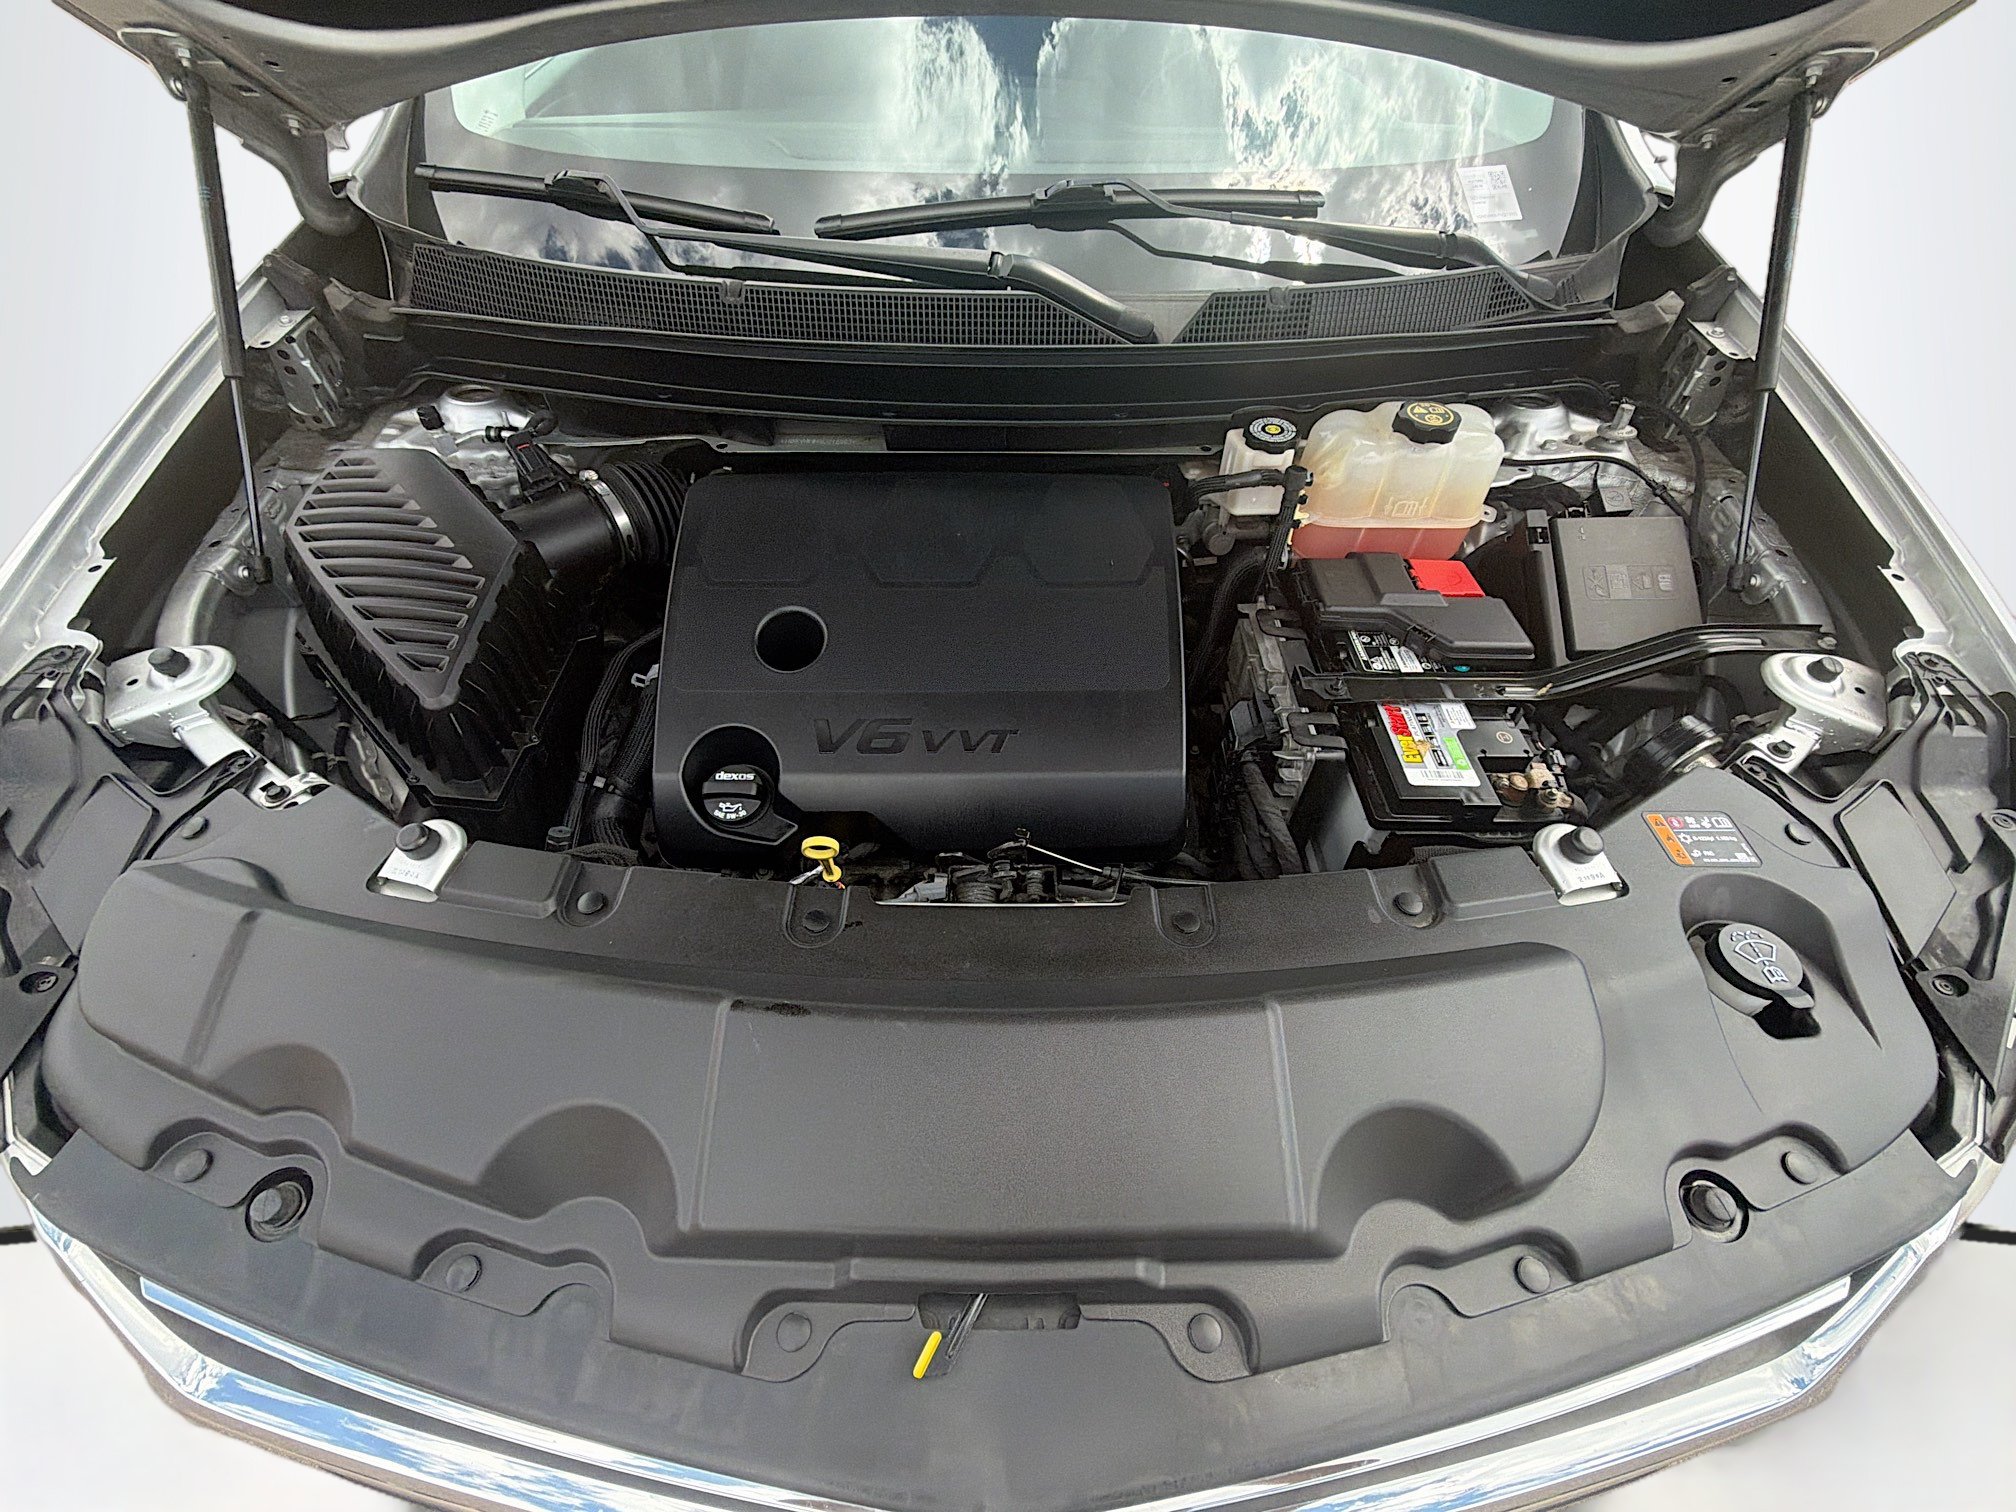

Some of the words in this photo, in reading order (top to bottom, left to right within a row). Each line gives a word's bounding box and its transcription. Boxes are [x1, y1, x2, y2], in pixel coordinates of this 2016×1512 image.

[813, 718, 914, 754] V6
[921, 729, 1020, 754] VVT
[1382, 703, 1424, 763] EverStart
[715, 771, 756, 781] dexos
